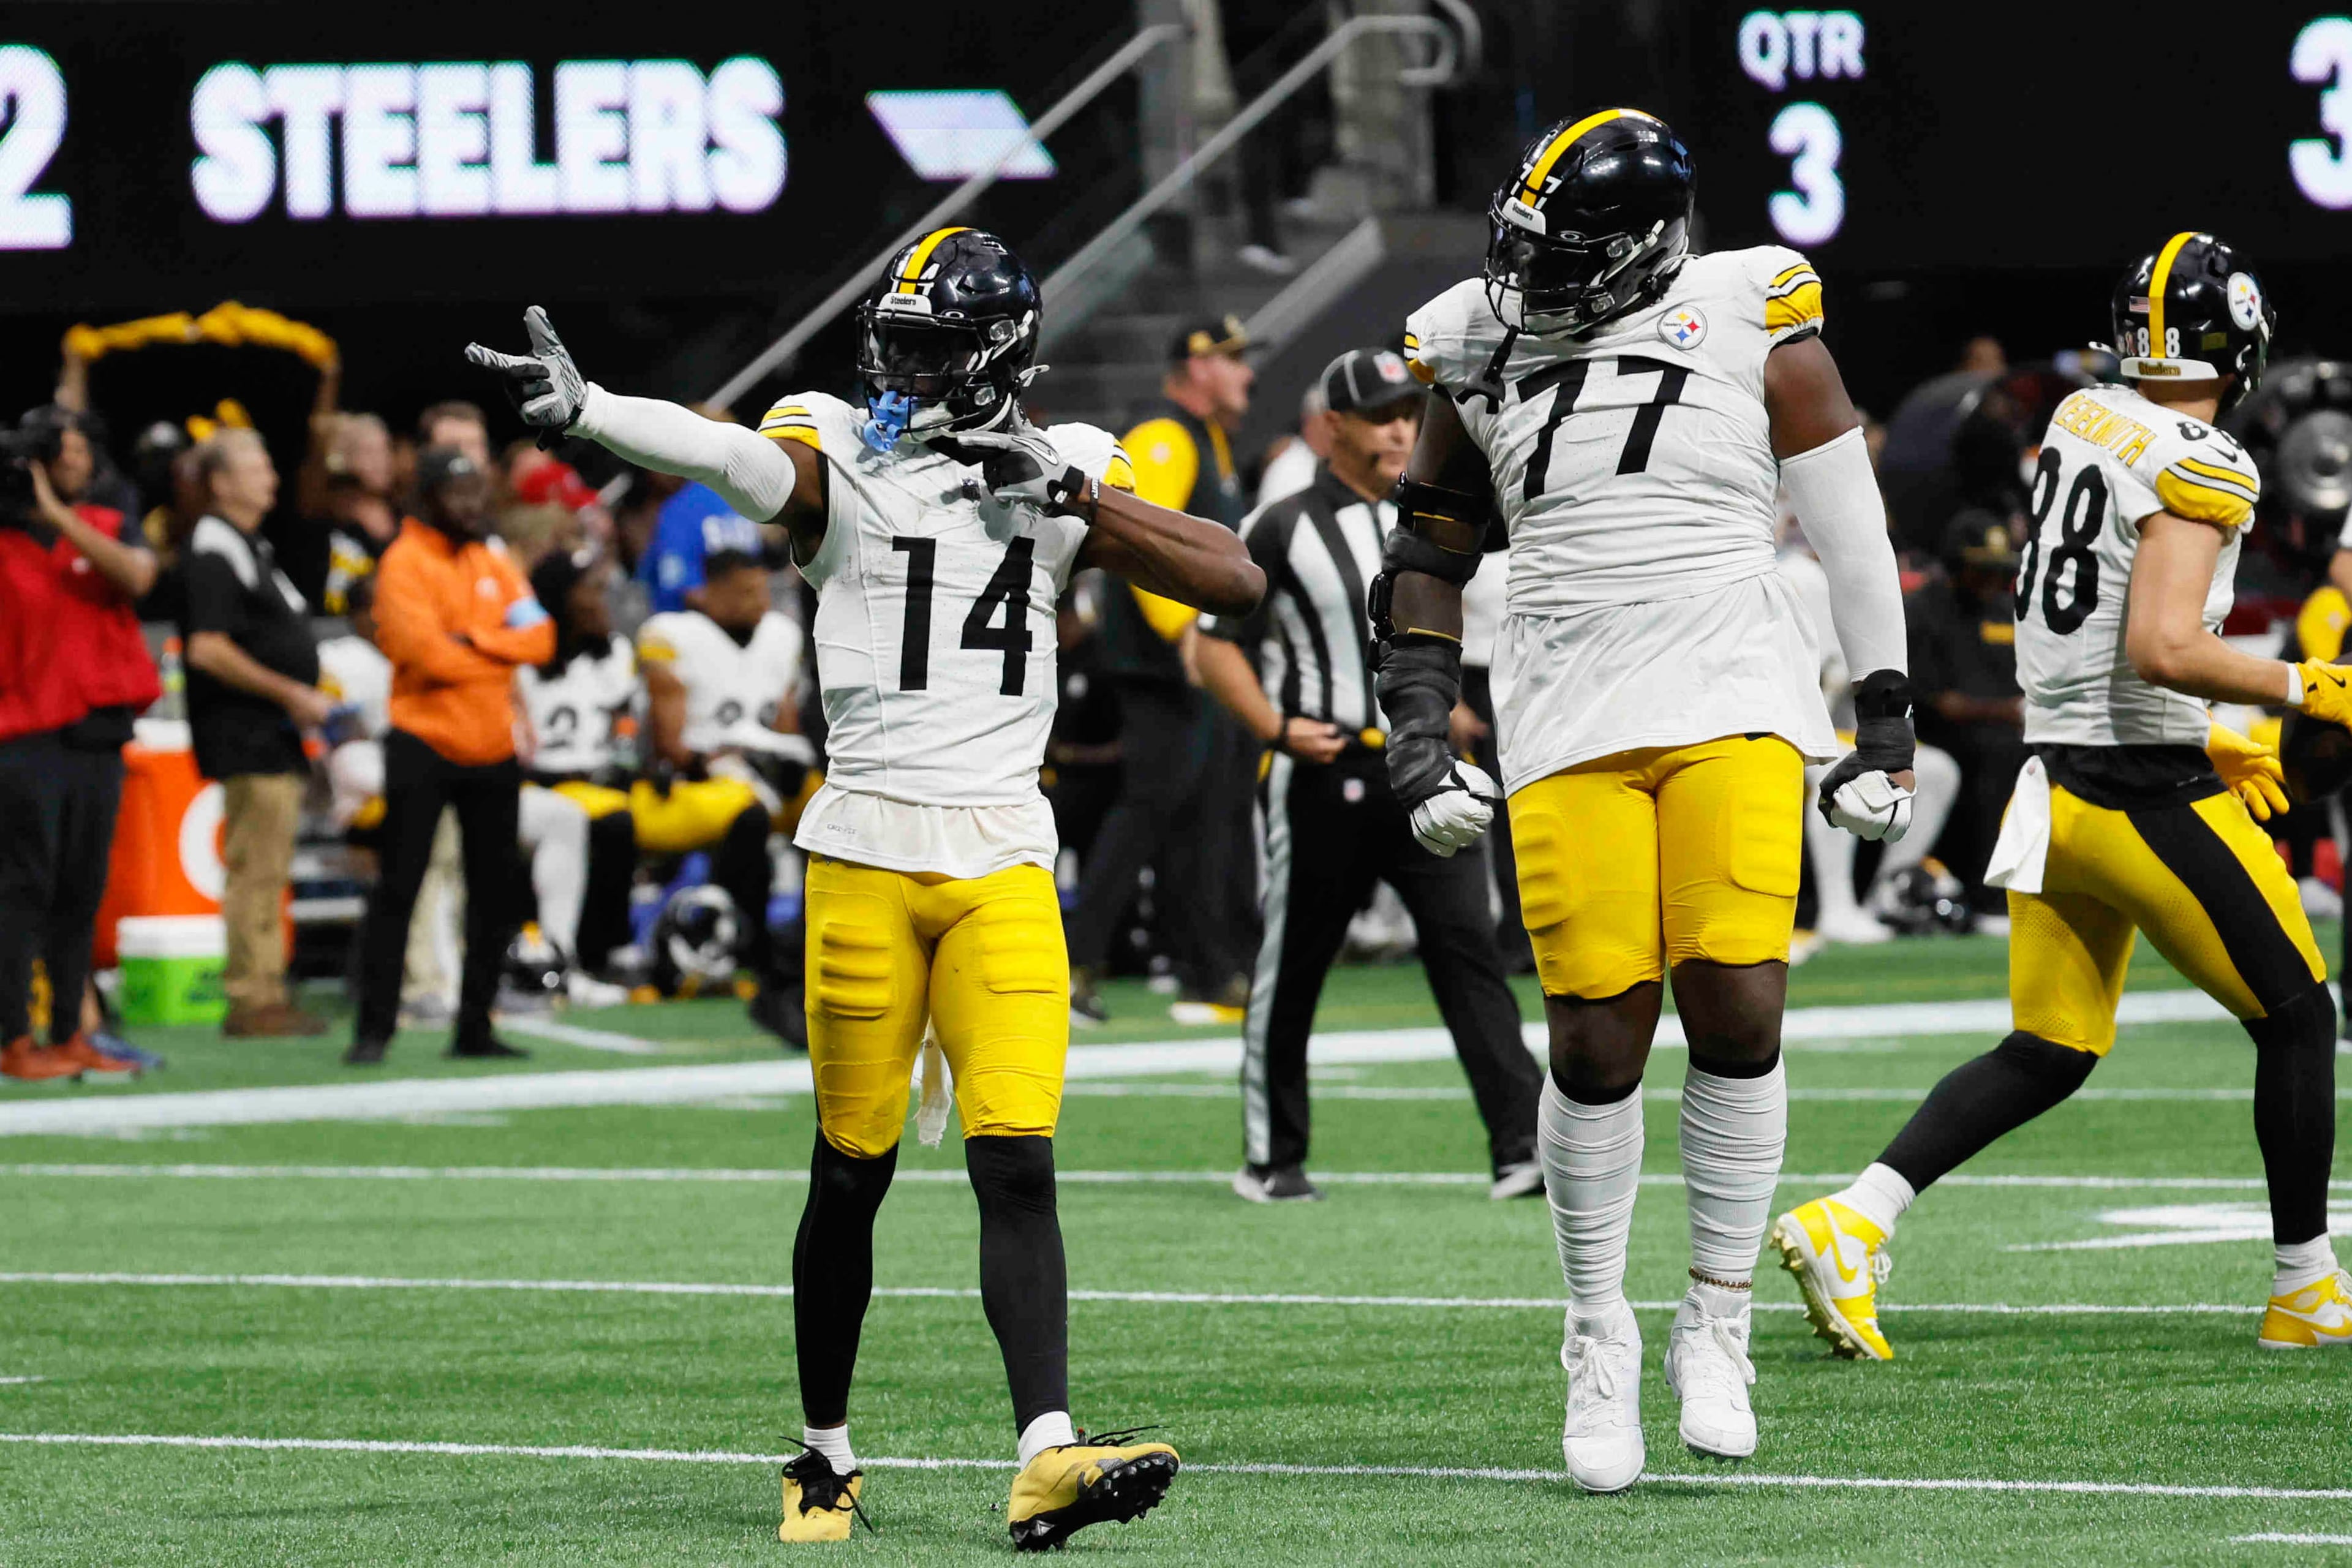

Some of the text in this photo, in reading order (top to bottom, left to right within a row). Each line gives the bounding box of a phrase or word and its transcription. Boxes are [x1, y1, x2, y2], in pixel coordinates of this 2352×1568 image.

[1738, 10, 1865, 91] QTR
[2290, 17, 2352, 208] 3
[0, 44, 72, 249] 2
[190, 55, 787, 223] STEELERS
[1768, 102, 1844, 245] 3
[890, 295, 916, 305] Steelers
[2137, 326, 2180, 358] 88
[1516, 355, 1695, 503] 77
[891, 535, 1036, 696] 14
[2015, 446, 2108, 636] 88
